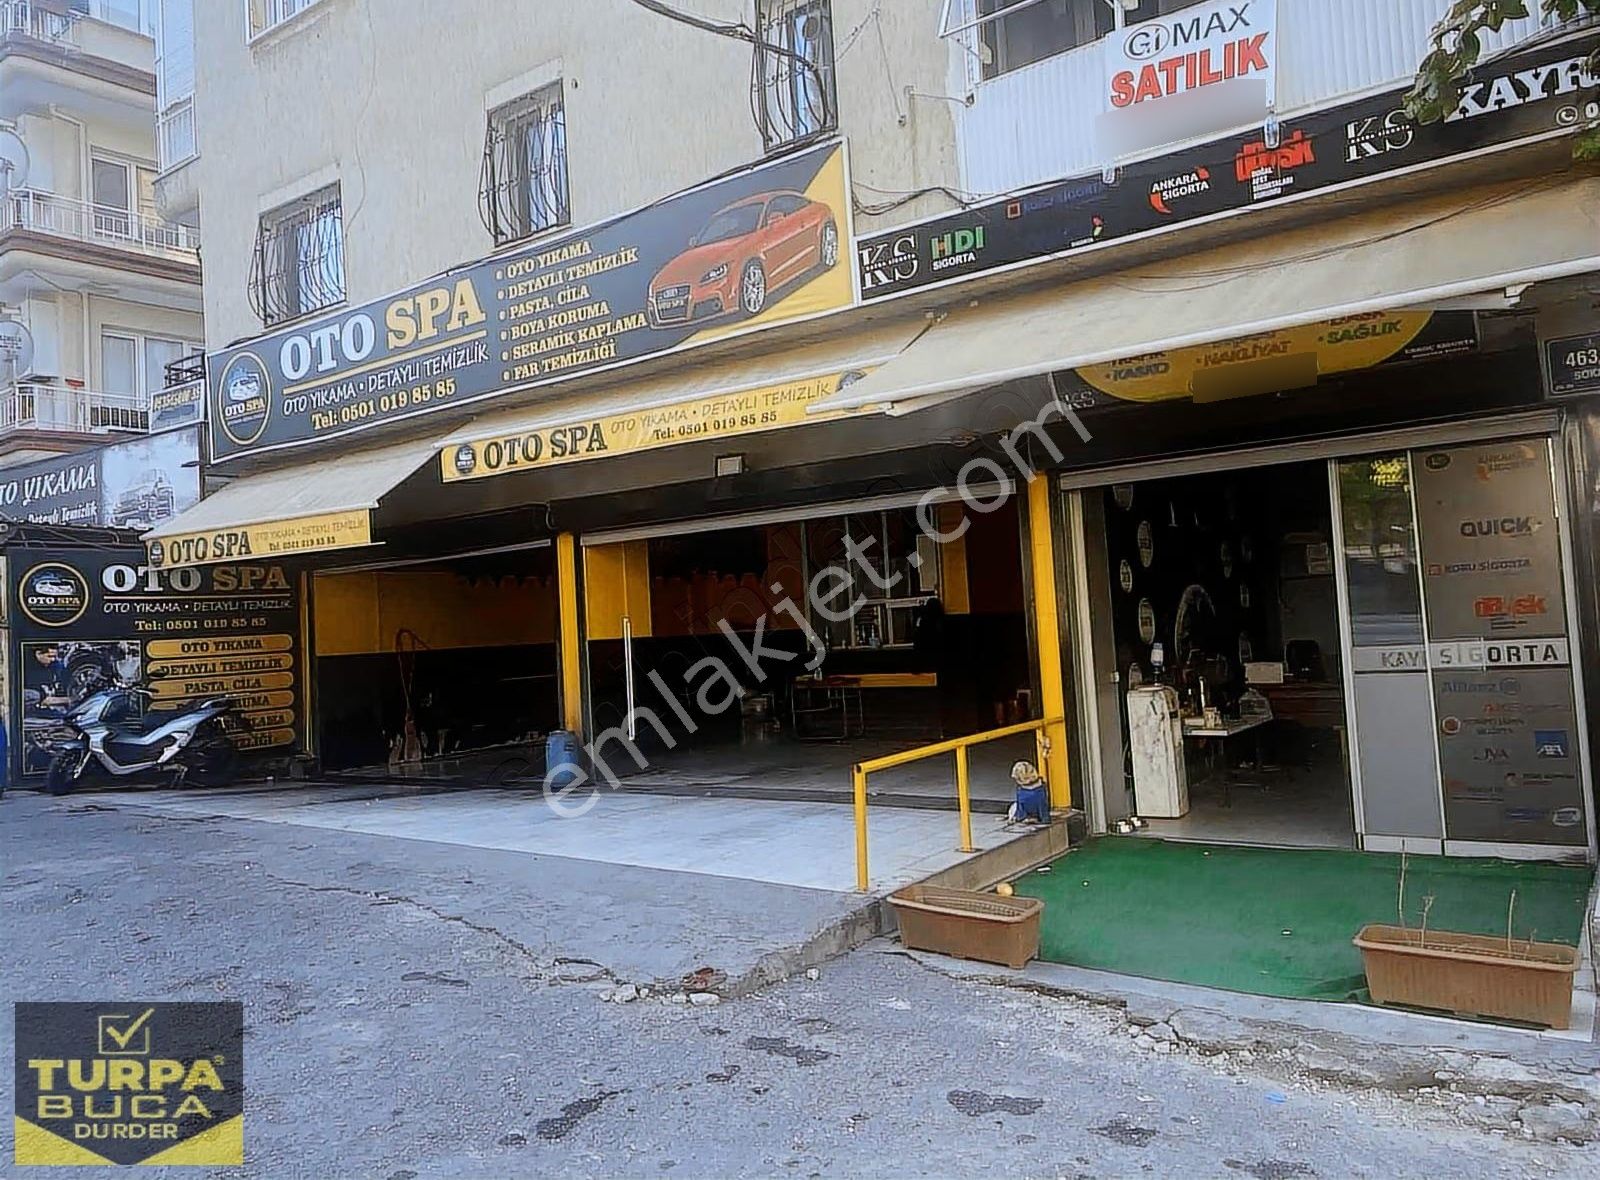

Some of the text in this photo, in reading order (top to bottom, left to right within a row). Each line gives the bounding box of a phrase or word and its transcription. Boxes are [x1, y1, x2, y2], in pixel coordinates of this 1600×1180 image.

[1110, 31, 1270, 108] SATILIK
[1345, 109, 1413, 162] KS
[1152, 172, 1199, 193] ANKARA
[507, 240, 593, 279] OTO YIKAMA
[931, 225, 985, 261] HDI
[508, 246, 640, 300] DETAYLI TEMİZLİK
[858, 234, 918, 290] KS
[557, 284, 591, 306] CİLA
[279, 277, 487, 381] OTO SPA
[511, 301, 611, 340] BOYA KORUMA
[512, 312, 649, 360] SERAMİK KAPLAMA
[283, 341, 489, 416] OTO YIKAMA DETAYLI TEMİZLİK
[513, 361, 540, 381] FAR
[225, 402, 246, 417] OTO
[311, 377, 456, 431] Tel: 0501 019 85 85
[611, 418, 636, 434] OTO
[639, 408, 689, 430] YIKAMA
[701, 397, 758, 418] DETAYLI
[653, 410, 778, 441] Tel: 0501 019 85 85
[483, 422, 608, 470] OTO SPA
[23, 463, 96, 507] YIKAMA
[1460, 515, 1532, 538] QUICK
[169, 529, 253, 565] OTO SPA
[101, 563, 292, 593] OTO SPA
[27, 595, 55, 606] OTO
[103, 602, 130, 614] OTO
[133, 600, 181, 614] YIKAMA
[181, 639, 263, 654] OTO YIKAMA
[160, 662, 217, 677] DETAYLI
